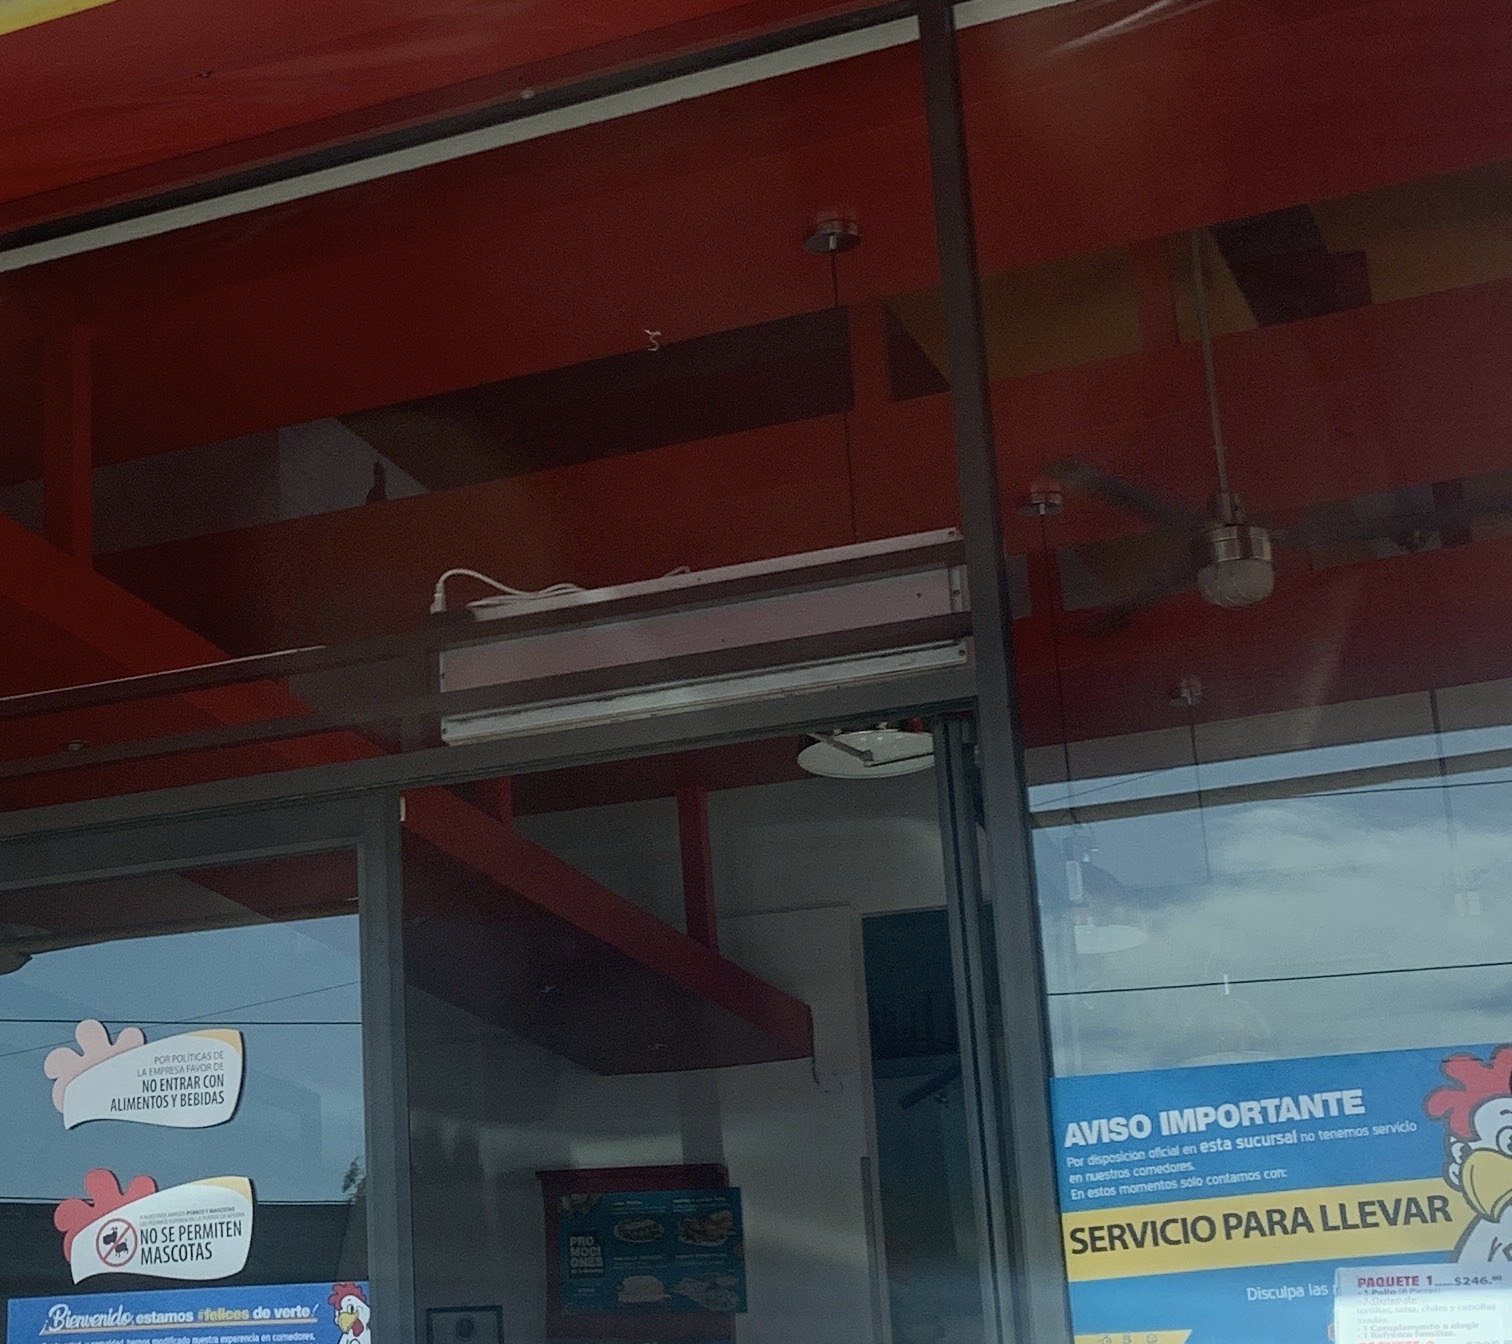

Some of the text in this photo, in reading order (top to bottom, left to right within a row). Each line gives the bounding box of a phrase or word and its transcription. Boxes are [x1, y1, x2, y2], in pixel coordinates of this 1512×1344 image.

[154, 1055, 172, 1065] POR
[213, 1050, 225, 1060] DE
[137, 1062, 224, 1077] LA EMPRESA FAVOR DE
[142, 1073, 225, 1093] NO ENTRAR CON
[110, 1090, 225, 1112] ALIMENTOS Y BEBIDAS
[1064, 1088, 1366, 1148] AVISO IMPORTANTE
[1066, 1156, 1084, 1169] Por
[1148, 1145, 1180, 1159] oficial
[1182, 1145, 1197, 1155] en
[1199, 1137, 1233, 1154] esta
[1235, 1128, 1297, 1150] sucursal
[1300, 1132, 1316, 1143] no
[1318, 1126, 1370, 1142] tenemos
[1372, 1119, 1418, 1136] servicio
[1069, 1160, 1196, 1184] en nuestros comedores.
[1070, 1188, 1085, 1201] En
[1087, 1185, 1117, 1199] estos
[1118, 1179, 1178, 1196] momentos
[1205, 1170, 1261, 1186] contamos
[1263, 1167, 1288, 1180] con:
[140, 1227, 158, 1245] NO
[161, 1226, 175, 1244] SE
[178, 1220, 242, 1242] PERMITEN
[1069, 1194, 1453, 1255] SERVICIO PARA LLEVAR
[140, 1241, 213, 1266] MASCOTAS
[1246, 1285, 1305, 1302] Disculpa
[1308, 1283, 1329, 1297] las
[1357, 1275, 1420, 1288] PAQUETE
[135, 1310, 194, 1324] estamos
[253, 1306, 271, 1319] de
